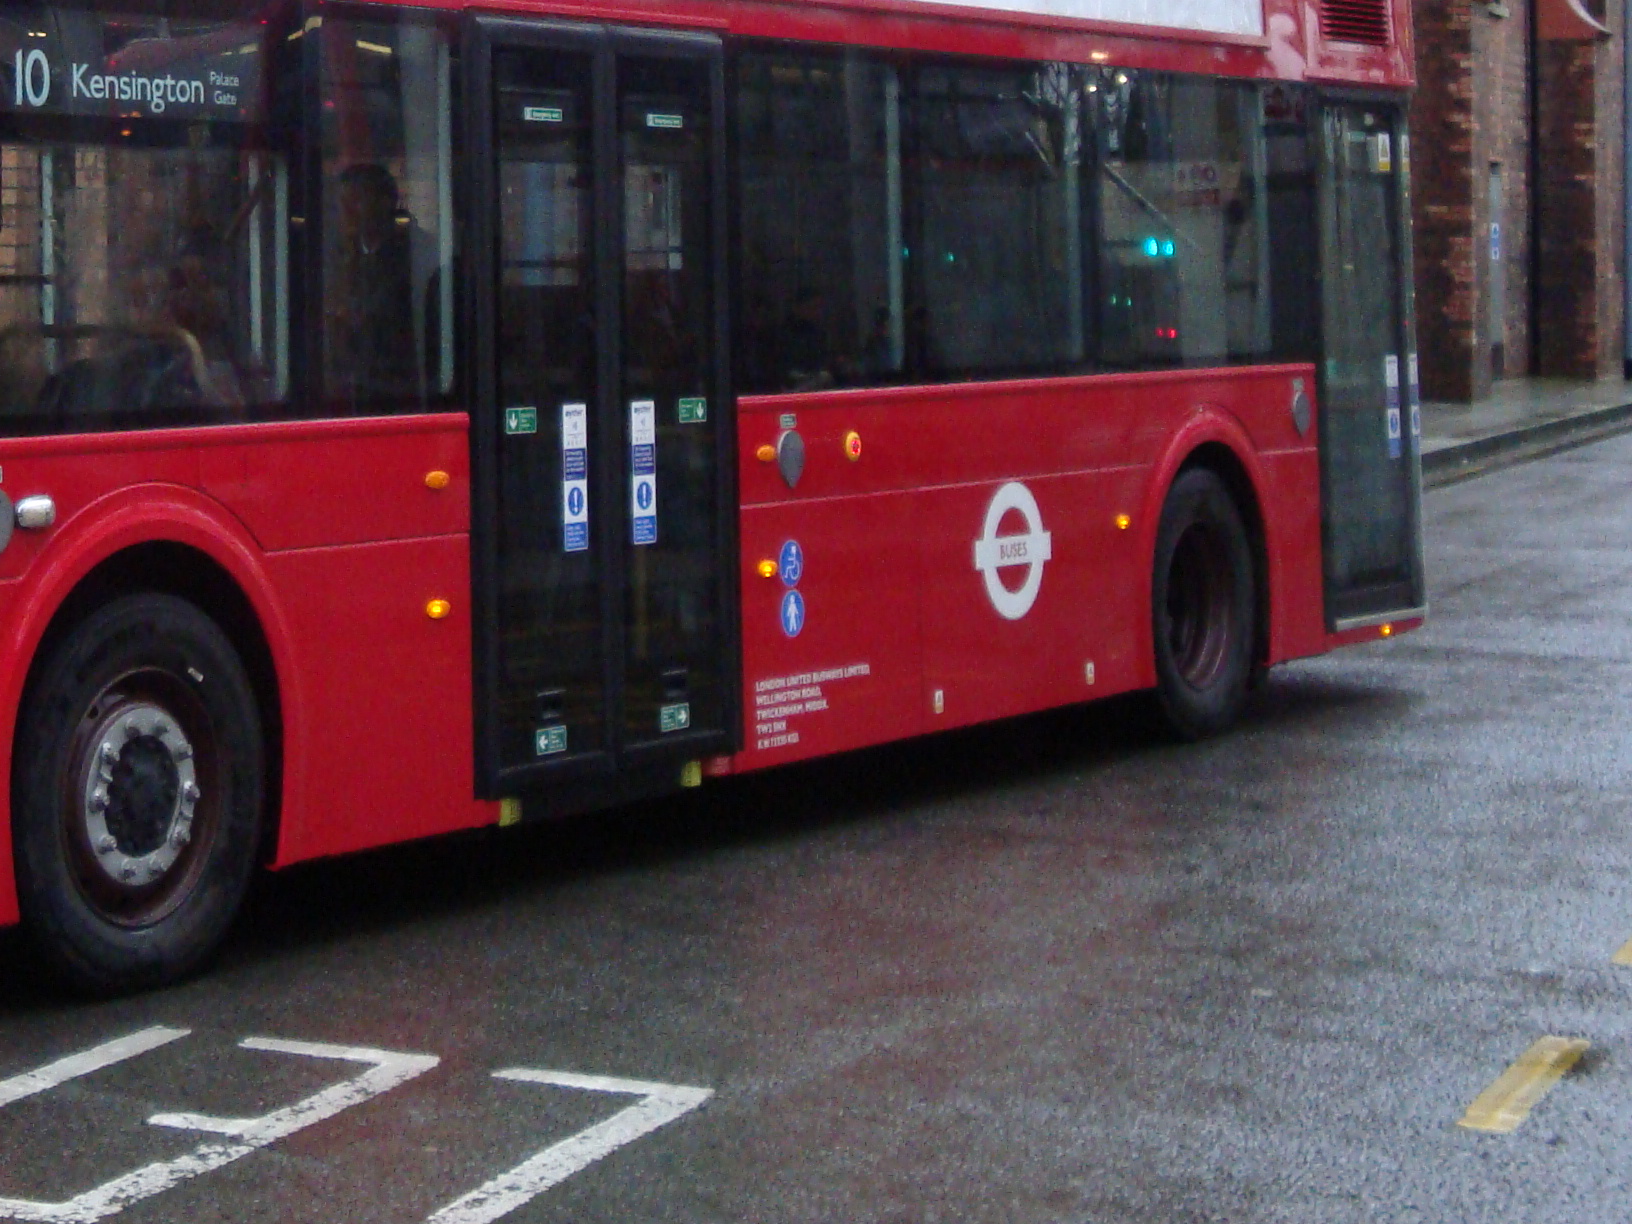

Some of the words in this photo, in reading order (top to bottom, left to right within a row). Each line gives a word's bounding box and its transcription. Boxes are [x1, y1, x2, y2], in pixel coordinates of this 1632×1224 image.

[14, 48, 51, 107] 10
[72, 62, 205, 114] Kensington
[210, 71, 239, 87] Palace
[214, 90, 237, 106] Gate
[1000, 542, 1027, 559] BUSES
[756, 678, 786, 692] LONDON
